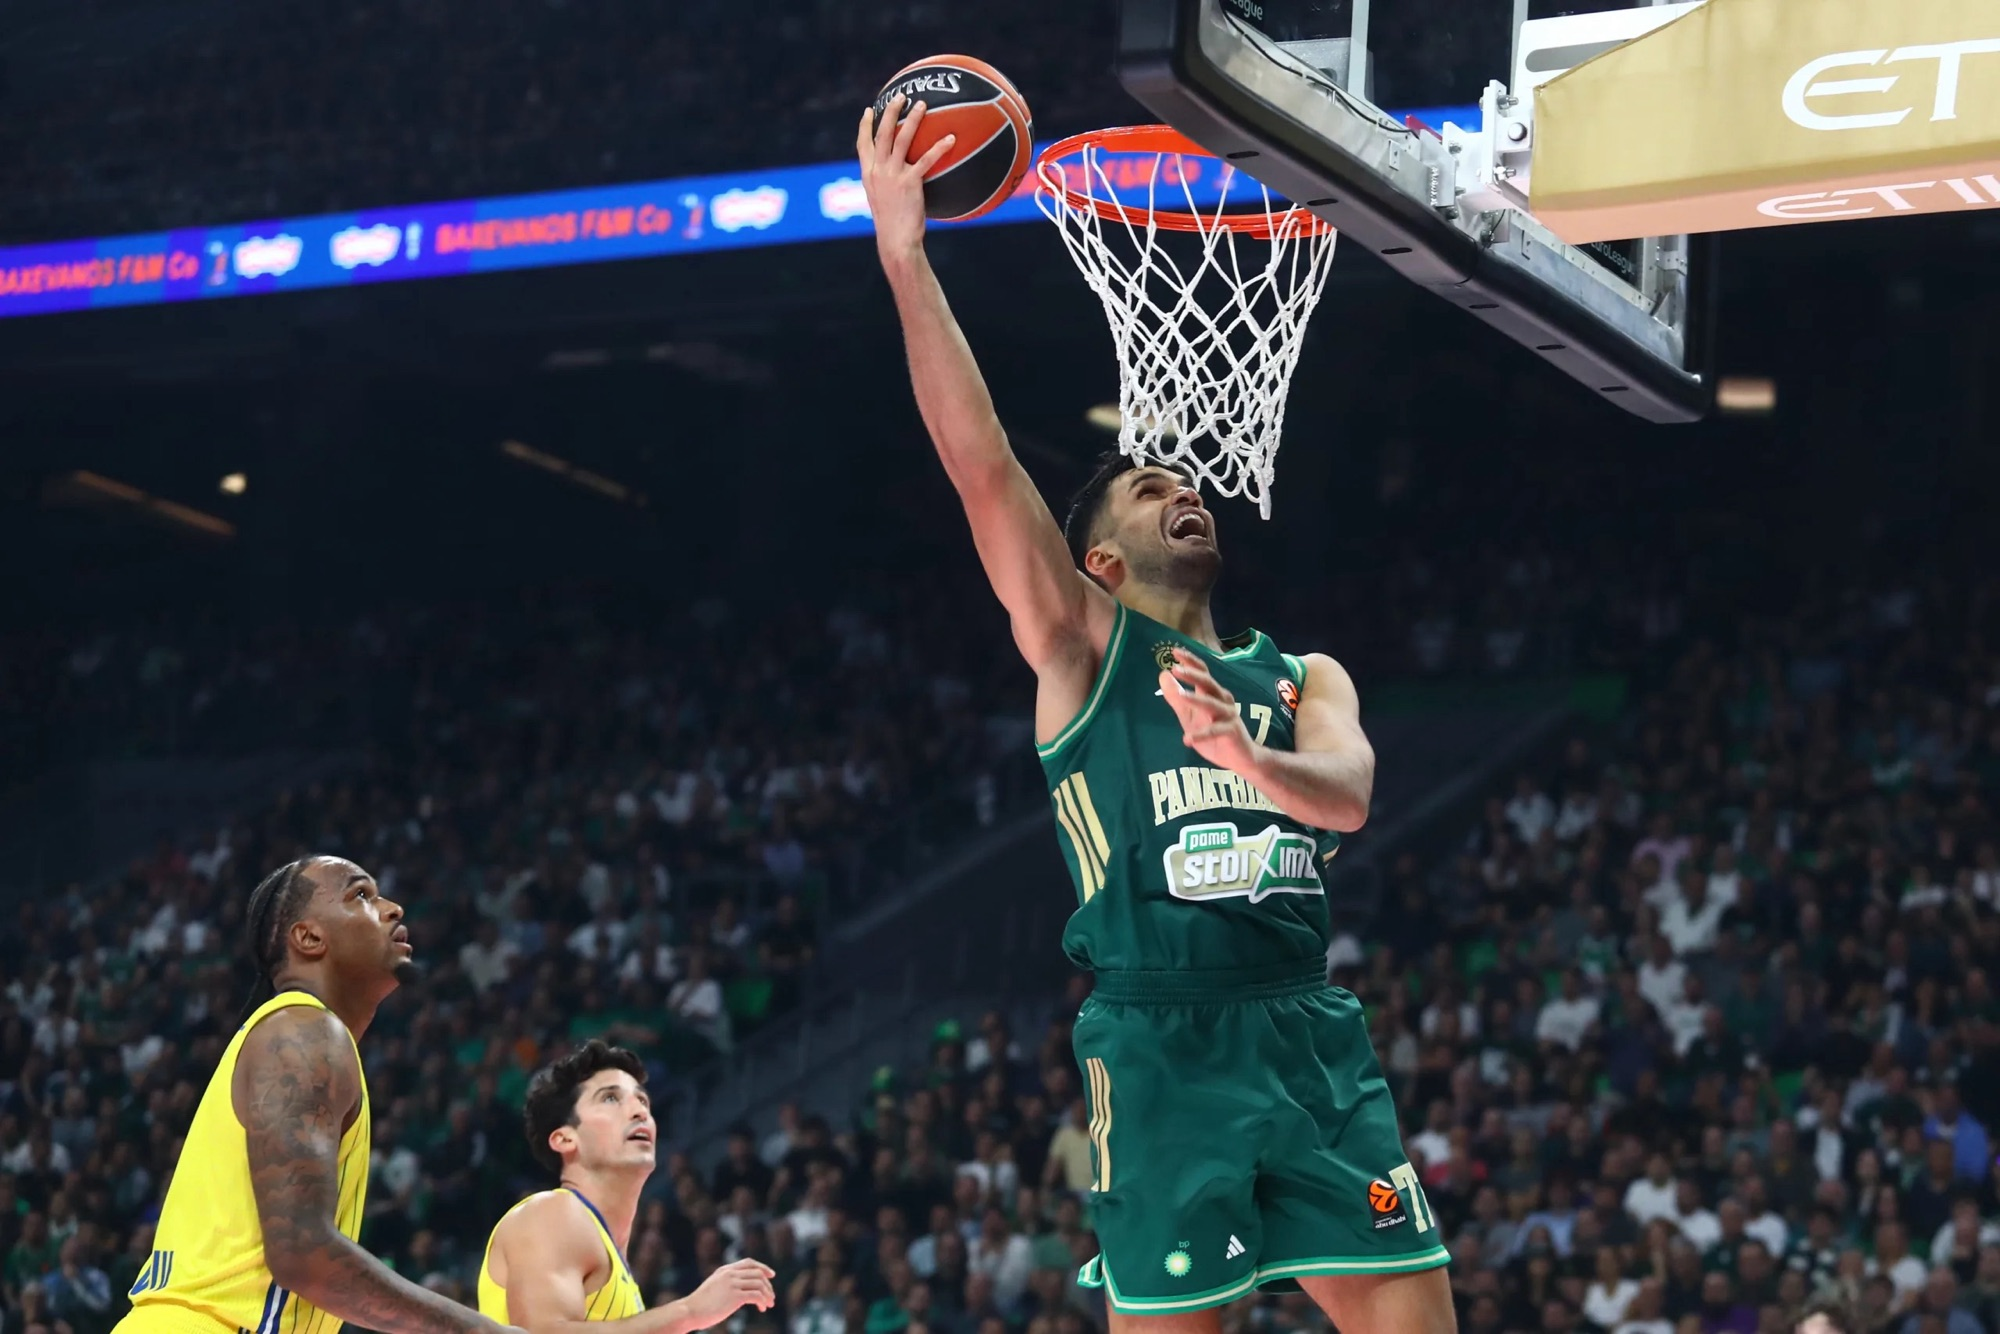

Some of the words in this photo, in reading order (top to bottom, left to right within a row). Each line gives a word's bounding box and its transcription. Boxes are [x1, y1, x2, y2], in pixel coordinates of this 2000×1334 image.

[1234, 702, 1273, 746] 7
[1190, 831, 1229, 850] pame
[1178, 1240, 1190, 1249] bp
